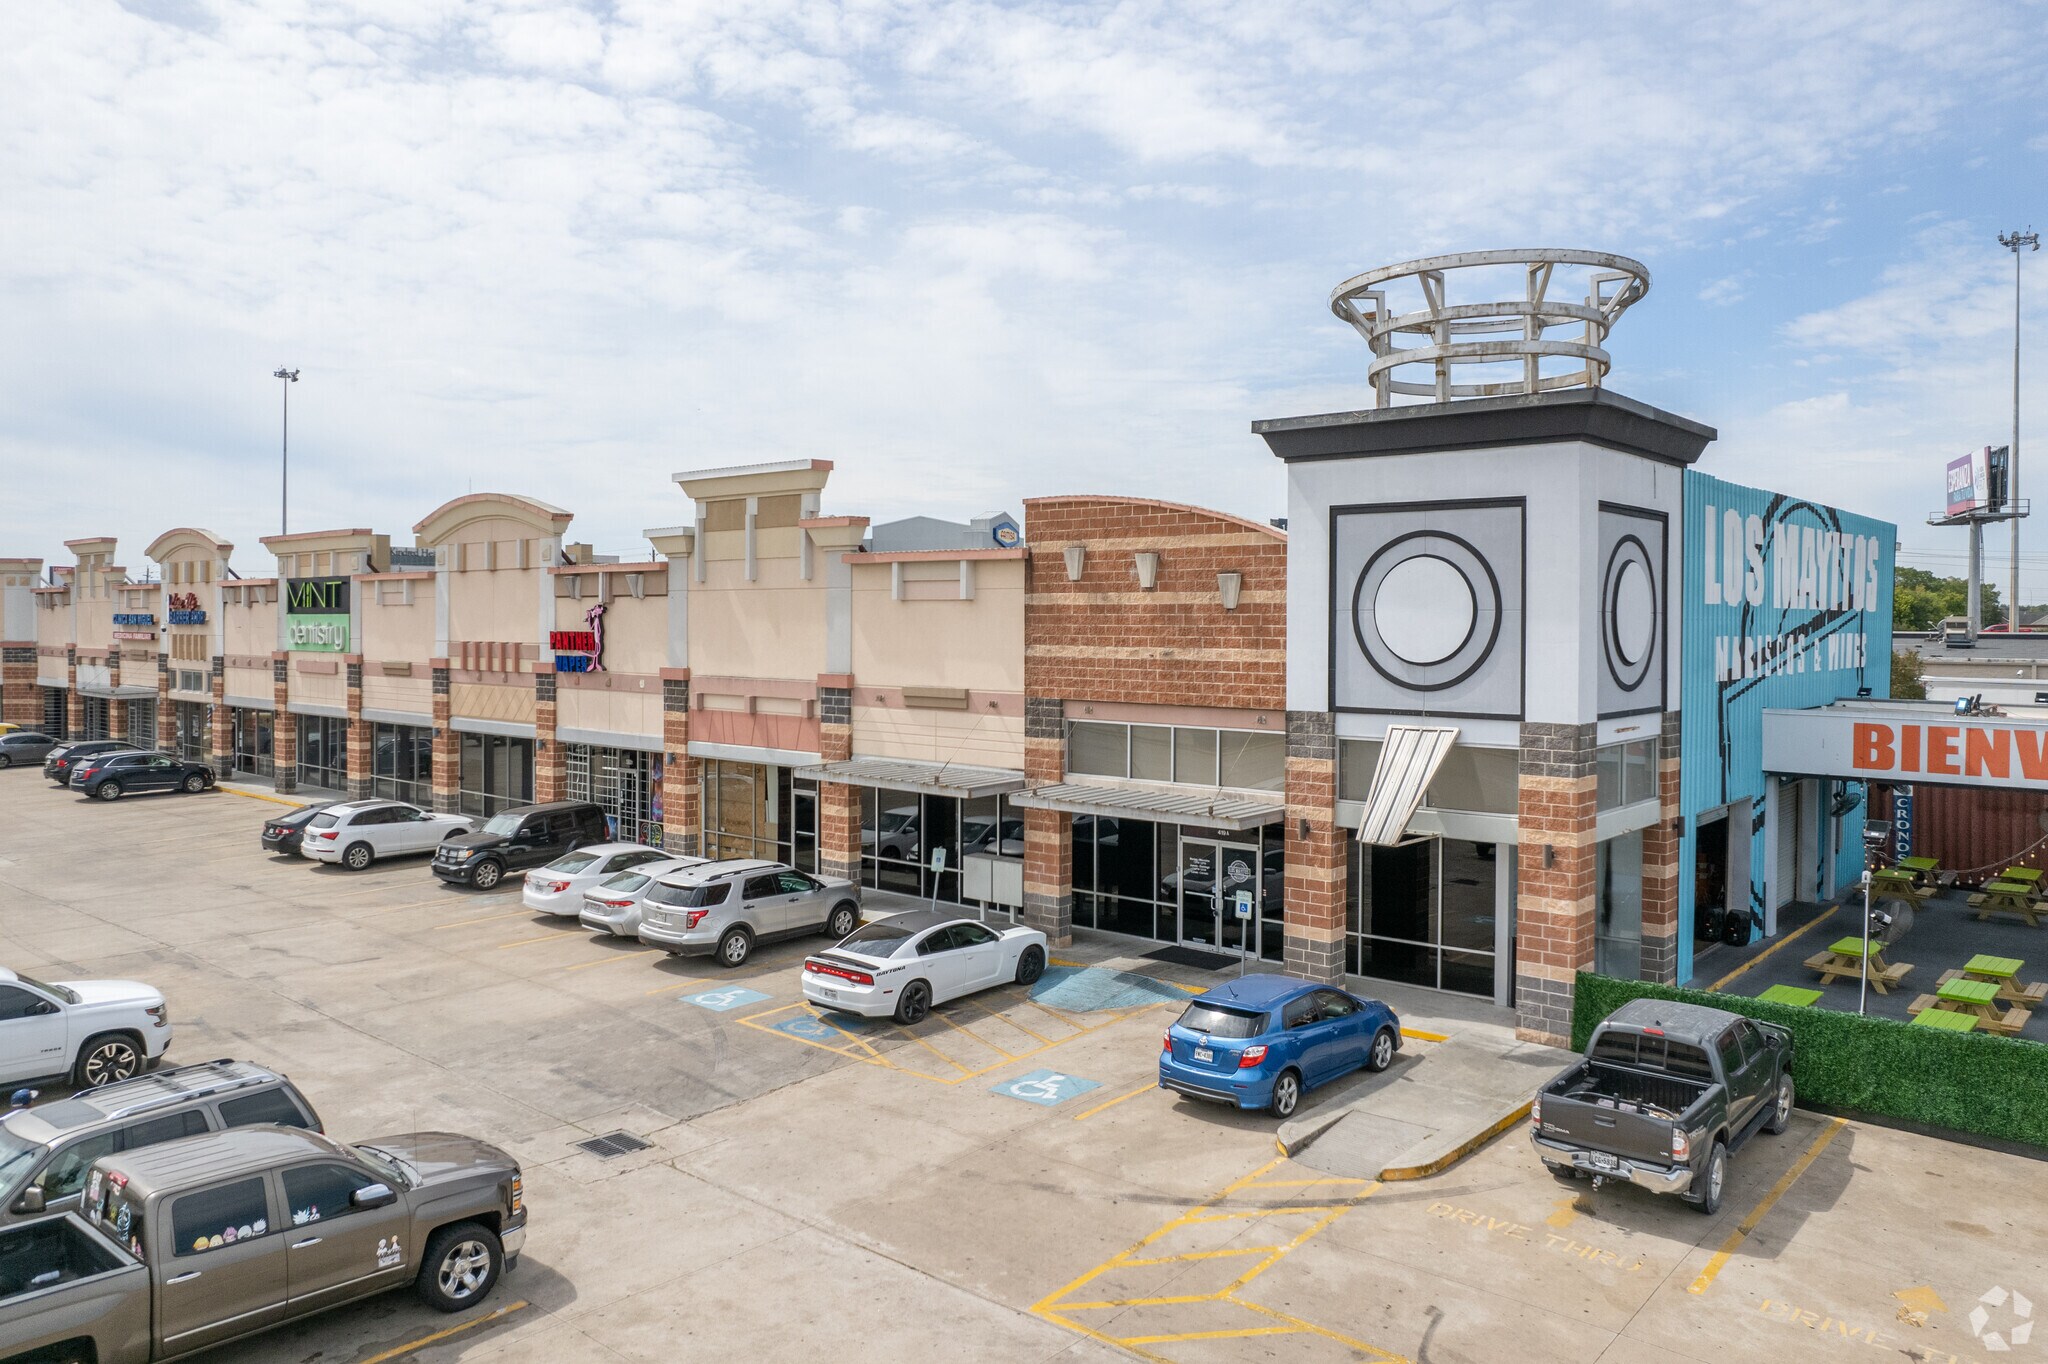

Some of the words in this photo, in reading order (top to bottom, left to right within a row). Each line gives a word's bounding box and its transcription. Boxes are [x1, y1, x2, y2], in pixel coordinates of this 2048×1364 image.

[1704, 504, 1765, 607] LOS
[1773, 520, 1879, 613] MAYITOS
[286, 581, 342, 608] MINT
[290, 619, 345, 650] dentistry
[550, 631, 595, 651] PANTHER
[555, 655, 588, 673] VAPES
[1715, 634, 1805, 682] MARISCOS
[876, 965, 906, 977] DAYTONA
[1425, 1201, 1533, 1240] DRIVE
[1545, 1233, 1647, 1272] THRU
[1759, 1298, 1898, 1351] DRIVE
